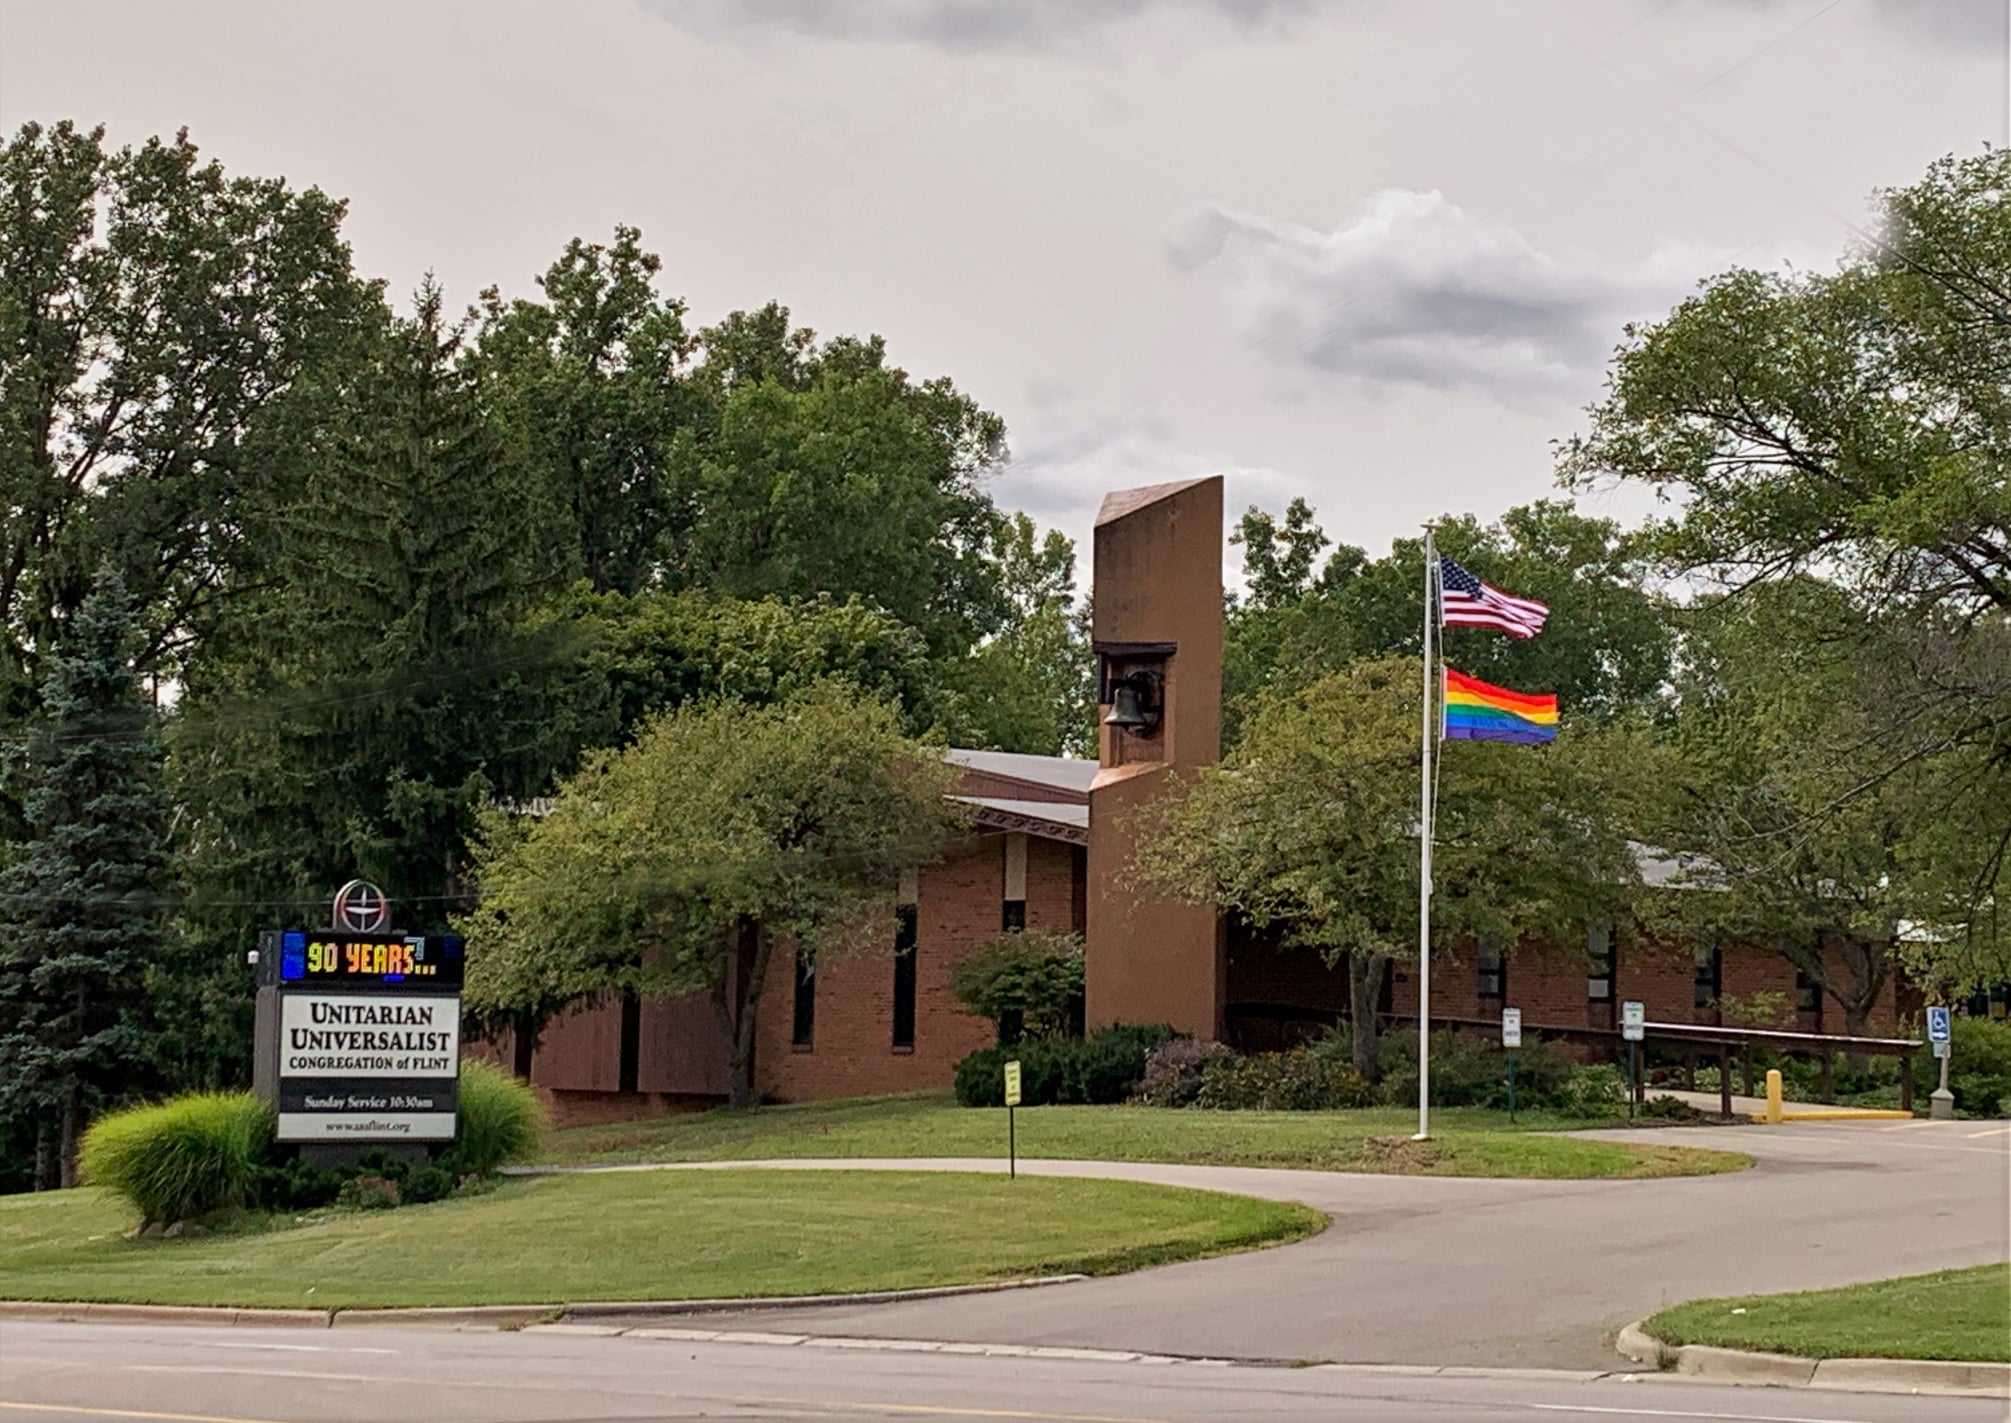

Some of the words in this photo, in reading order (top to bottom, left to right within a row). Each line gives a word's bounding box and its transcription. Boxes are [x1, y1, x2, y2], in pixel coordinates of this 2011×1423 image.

[308, 942, 338, 973] 90
[346, 943, 436, 975] YEARS...
[310, 1003, 433, 1025] UNITARIAN
[290, 1028, 450, 1052] UNIVERSALIST
[289, 1056, 393, 1070] CONGREGATION
[397, 1056, 411, 1070] of
[412, 1057, 449, 1071] FLINT
[304, 1095, 345, 1110] Sunday
[347, 1095, 387, 1108] Service
[390, 1095, 433, 1109] 10:30am
